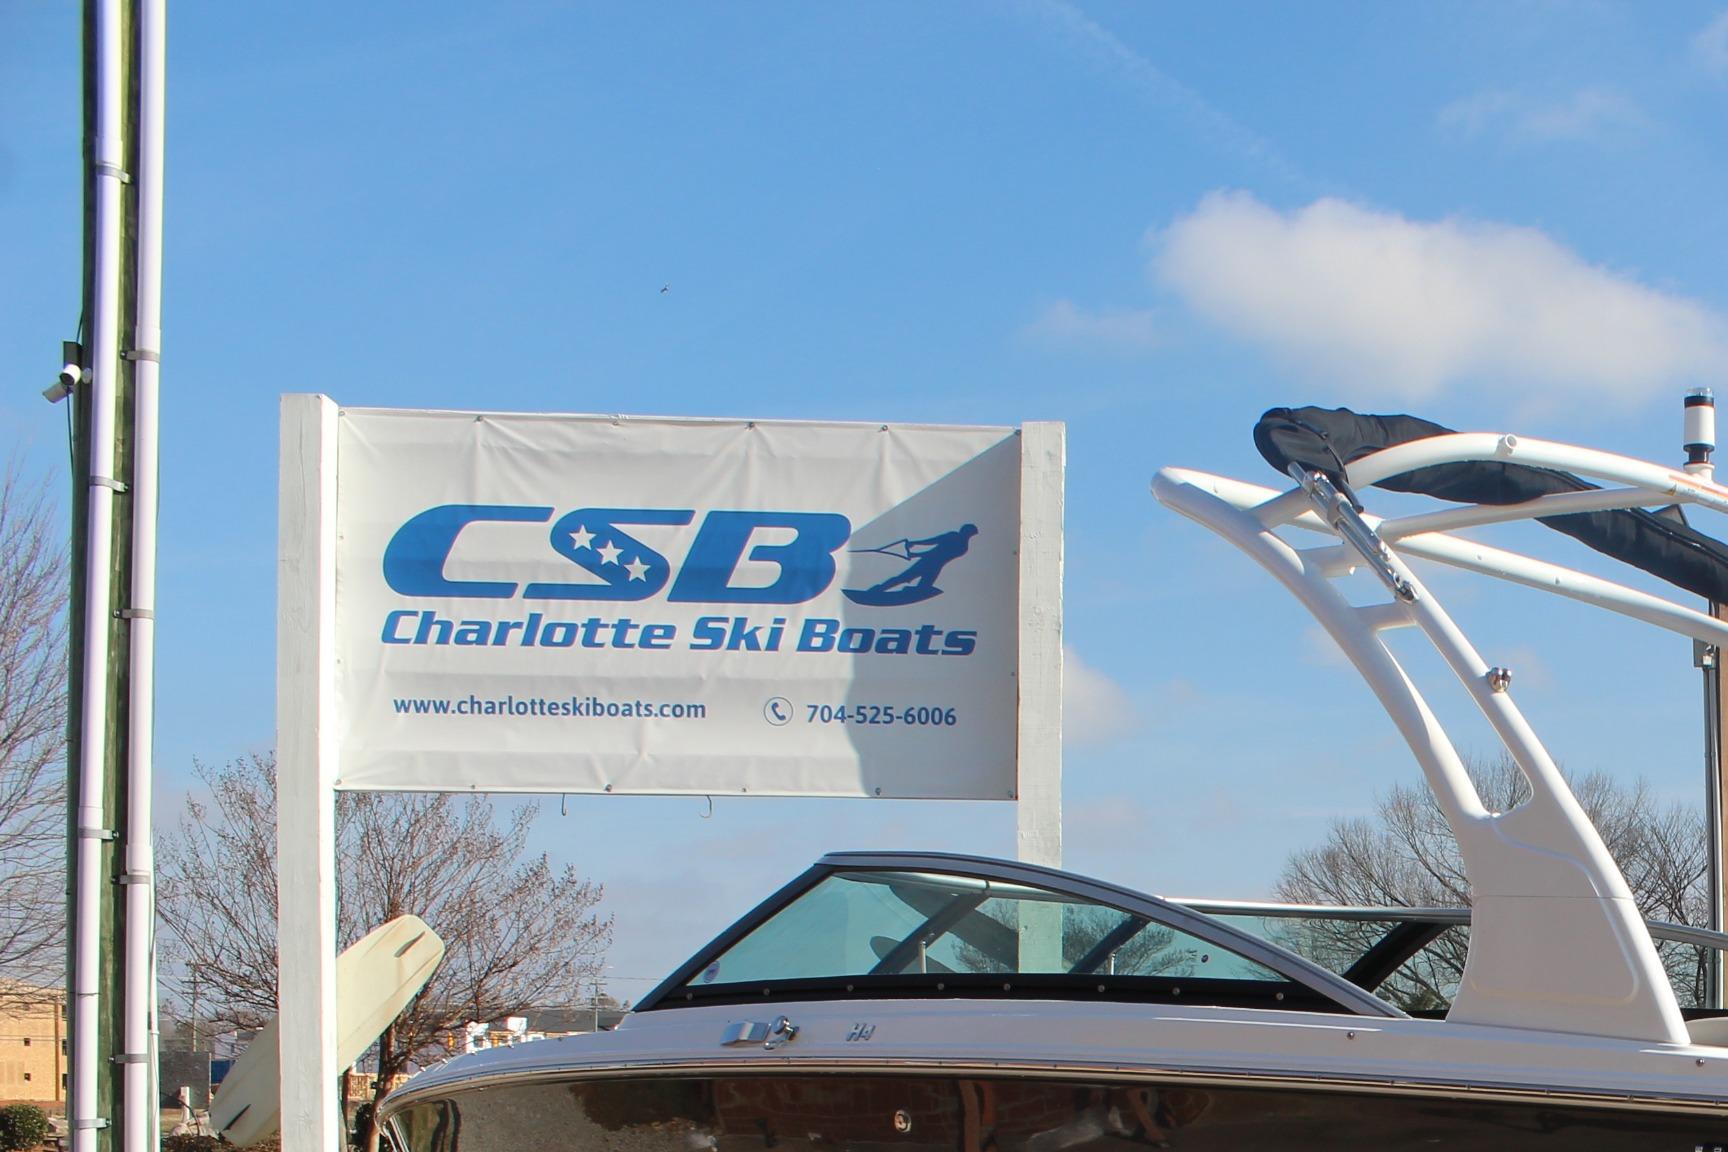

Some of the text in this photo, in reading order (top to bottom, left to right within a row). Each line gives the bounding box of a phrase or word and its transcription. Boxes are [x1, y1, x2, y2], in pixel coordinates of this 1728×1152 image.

[382, 503, 852, 605] CSB
[381, 609, 977, 656] Charlotte Ski Boats
[393, 694, 706, 720] www.charlotteskiboats.com
[807, 703, 957, 727] 704-525-6006
